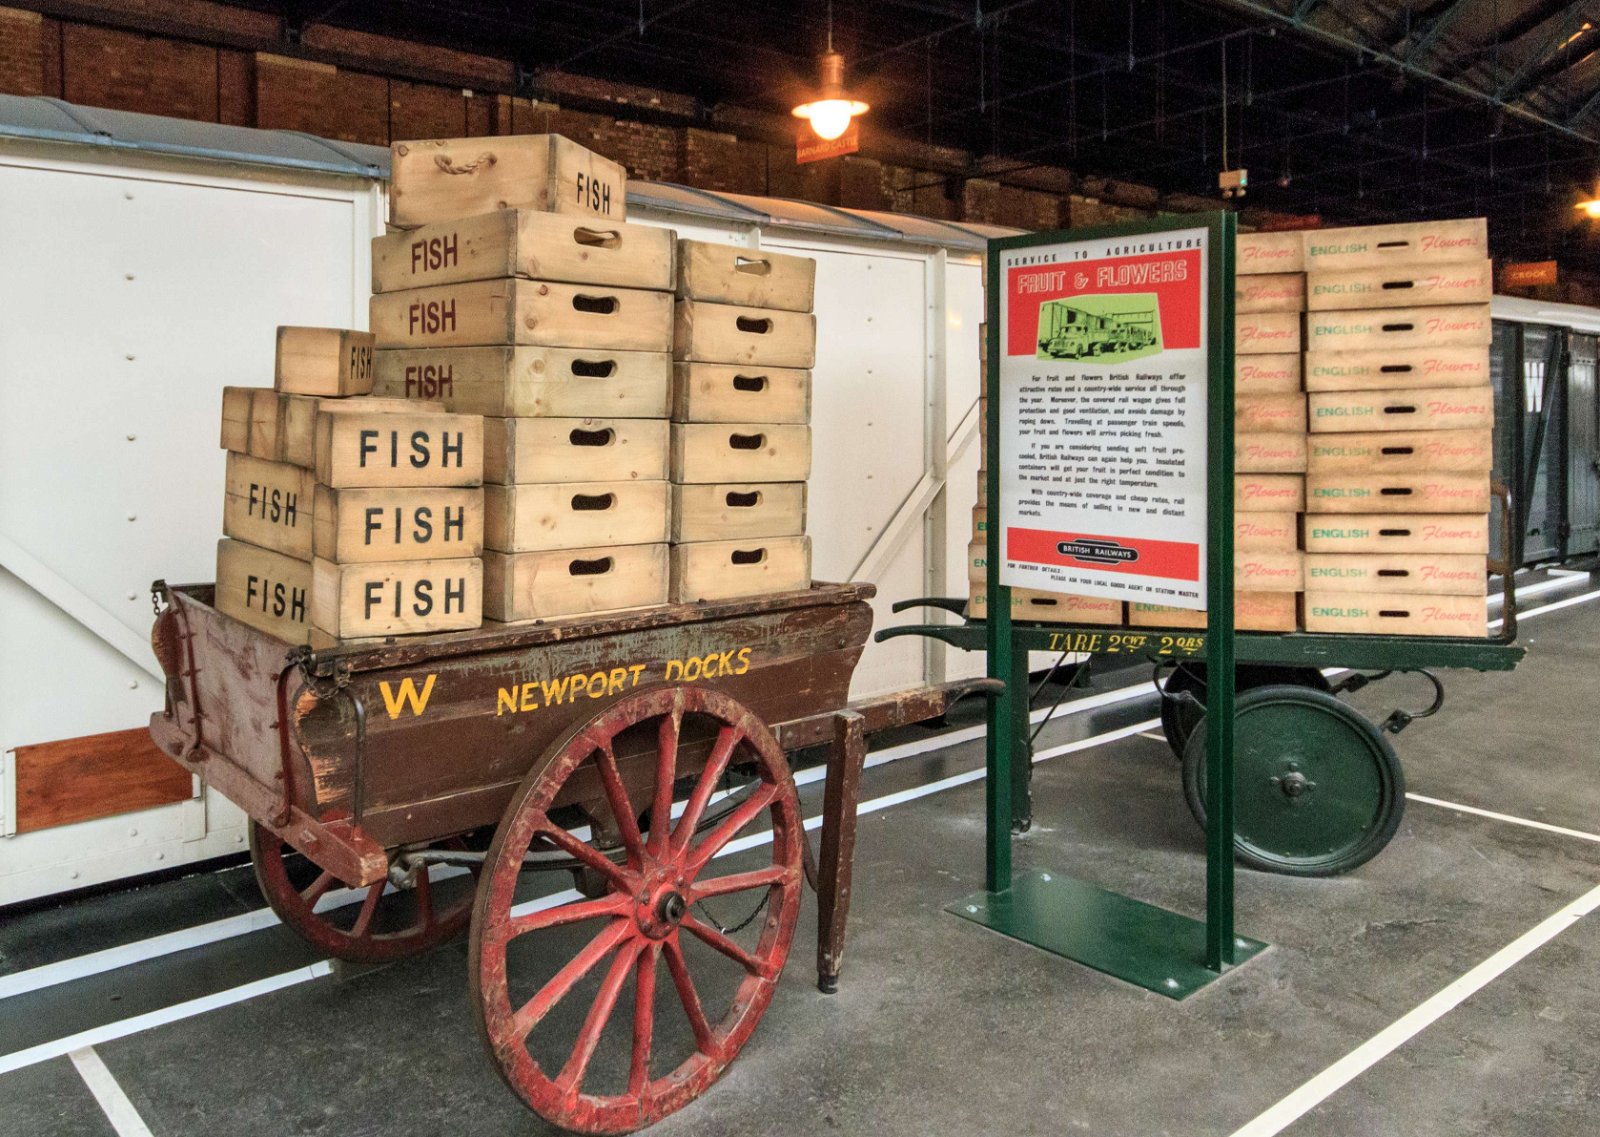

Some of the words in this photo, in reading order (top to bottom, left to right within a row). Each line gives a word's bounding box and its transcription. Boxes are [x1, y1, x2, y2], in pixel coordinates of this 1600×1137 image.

[576, 172, 612, 216] FISH
[411, 232, 458, 274] FISH
[1008, 254, 1057, 266] SERVICE
[1075, 251, 1088, 259] TO
[1107, 238, 1201, 257] AGRICULTURE
[1311, 244, 1367, 256] ENGLISH
[1421, 237, 1479, 252] Flowers
[1018, 271, 1066, 294] FRUIT
[1074, 272, 1088, 289] &
[1097, 260, 1187, 287] FLOWERS
[1313, 283, 1372, 294] ENGLISH
[1425, 277, 1487, 292] Flowers
[408, 298, 456, 336] FISH
[1315, 325, 1372, 336] ENGLISH
[1426, 319, 1483, 334] Flowers
[350, 345, 372, 379] FISH
[405, 364, 453, 398] FISH
[1316, 407, 1374, 417] ENGLISH
[1427, 402, 1485, 417] Flowers
[359, 430, 464, 468] FISH
[1061, 454, 1084, 462] Railways
[248, 483, 297, 527] FISH
[1047, 490, 1082, 498] country-wide
[1314, 487, 1370, 498] ENGLISH
[1094, 503, 1112, 511] selling
[364, 506, 465, 545] FISH
[1312, 529, 1369, 538] ENGLISH
[1422, 525, 1481, 540] Flowers
[1063, 545, 1090, 554] BRITISH
[1095, 548, 1132, 559] RAILWAYS
[246, 575, 306, 623] FISH
[364, 578, 466, 619] FISH
[1312, 608, 1368, 617] ENGLISH
[1421, 606, 1480, 622] Flowers
[1050, 633, 1102, 651] TARE
[380, 674, 437, 720] W
[497, 664, 646, 716] NEWPORT
[665, 648, 752, 682] DOCKS
